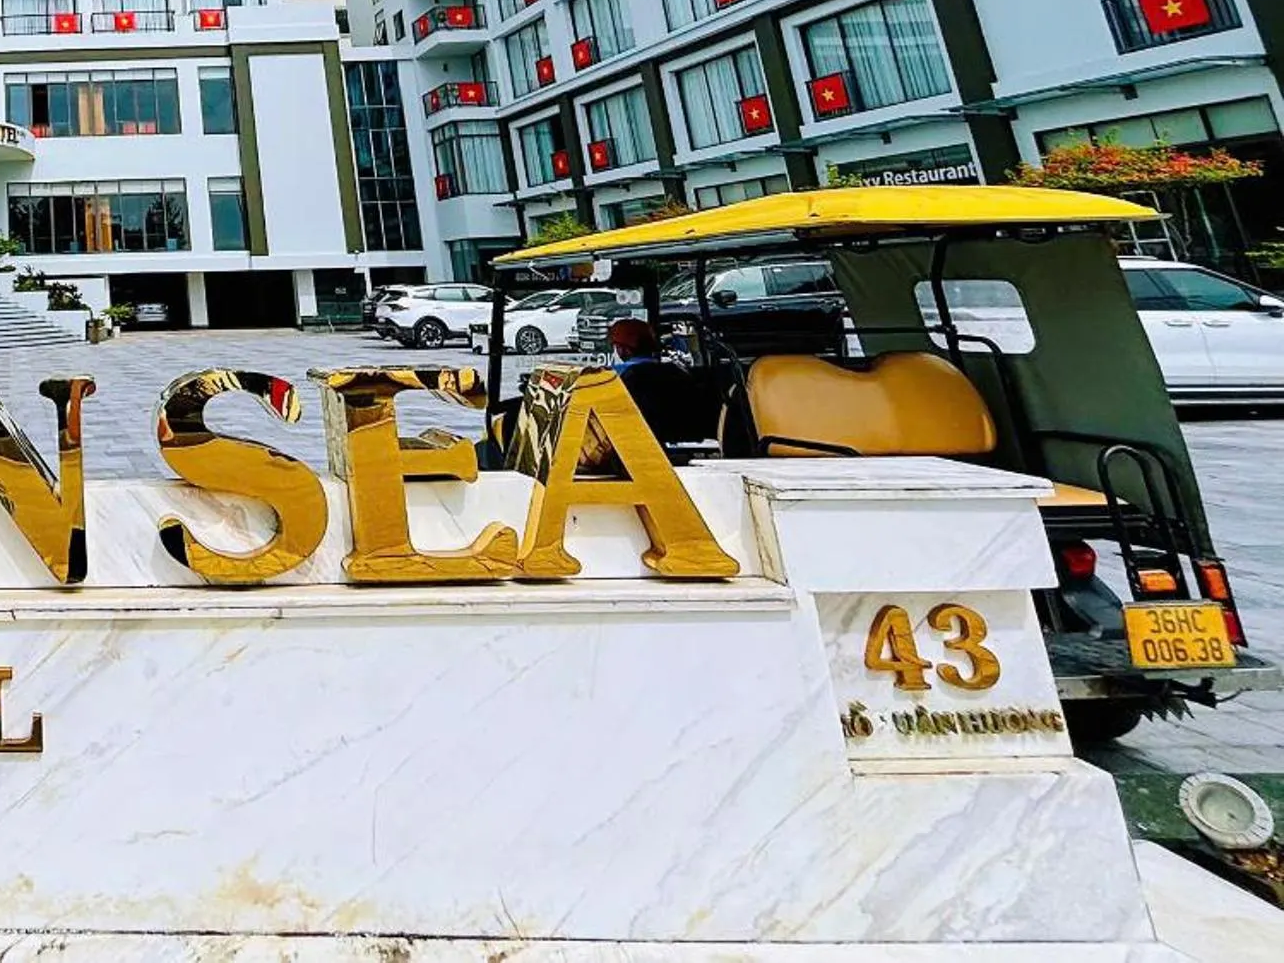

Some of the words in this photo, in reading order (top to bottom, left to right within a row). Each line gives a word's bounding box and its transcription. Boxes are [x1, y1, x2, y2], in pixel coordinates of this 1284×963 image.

[882, 160, 978, 187] Restaurant
[156, 365, 741, 585] SEA
[1146, 608, 1208, 634] 36HC
[864, 602, 1001, 691] 43
[1142, 637, 1224, 663] 006.38
